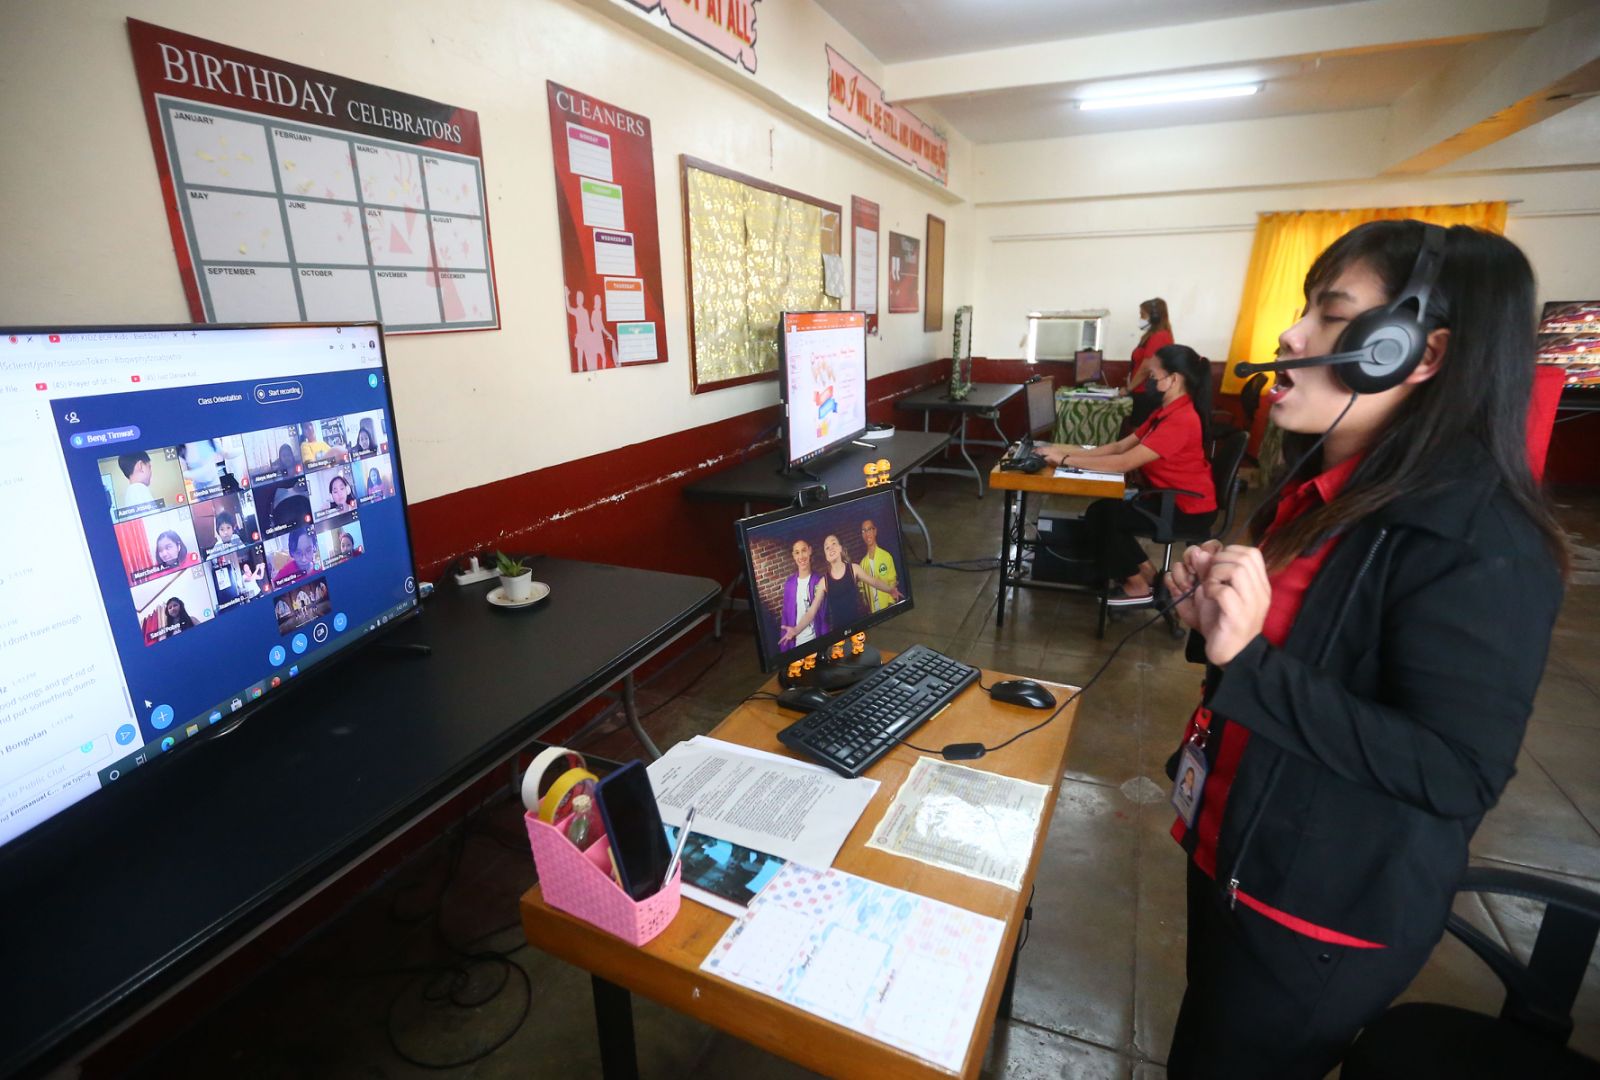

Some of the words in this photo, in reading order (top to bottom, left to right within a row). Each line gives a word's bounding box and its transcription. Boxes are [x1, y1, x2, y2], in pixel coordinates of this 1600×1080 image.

[726, 0, 752, 45] ALL
[157, 43, 337, 117] BIRTHDAY
[347, 99, 462, 144] CELEBRATORS
[830, 69, 846, 105] AND
[857, 88, 873, 124] WILL
[174, 112, 214, 126] JANUARY
[556, 91, 645, 137] CLEANERS
[274, 130, 312, 143] FEBRUARY
[356, 145, 379, 155] MARCH
[190, 191, 209, 201] MAY
[288, 201, 306, 210] JUNE
[366, 209, 382, 217] JULY
[432, 216, 453, 224] AUGUST
[600, 235, 627, 243] WEDNESDAY
[207, 267, 256, 276] SEPTEMBER
[300, 269, 333, 278] OCTOBER
[377, 271, 408, 279] NOVEMBER
[440, 272, 466, 280] DECEMBER
[268, 389, 280, 397] Start
[280, 385, 301, 396] recording
[197, 397, 213, 406] Class
[213, 393, 243, 404] Orientation
[87, 434, 107, 444] Beng
[8, 633, 29, 646] dont
[30, 626, 51, 639] have
[51, 614, 83, 631] enough
[150, 629, 166, 640] Sarah
[17, 687, 44, 703] songs
[44, 680, 60, 691] and
[61, 674, 74, 687] get
[75, 668, 86, 679] rid
[87, 664, 97, 673] of
[12, 707, 29, 722] put
[29, 688, 74, 712] something
[73, 678, 97, 693] dumb
[18, 776, 46, 794] Public
[10, 792, 48, 817] Emmanuel
[72, 770, 92, 786] typing
